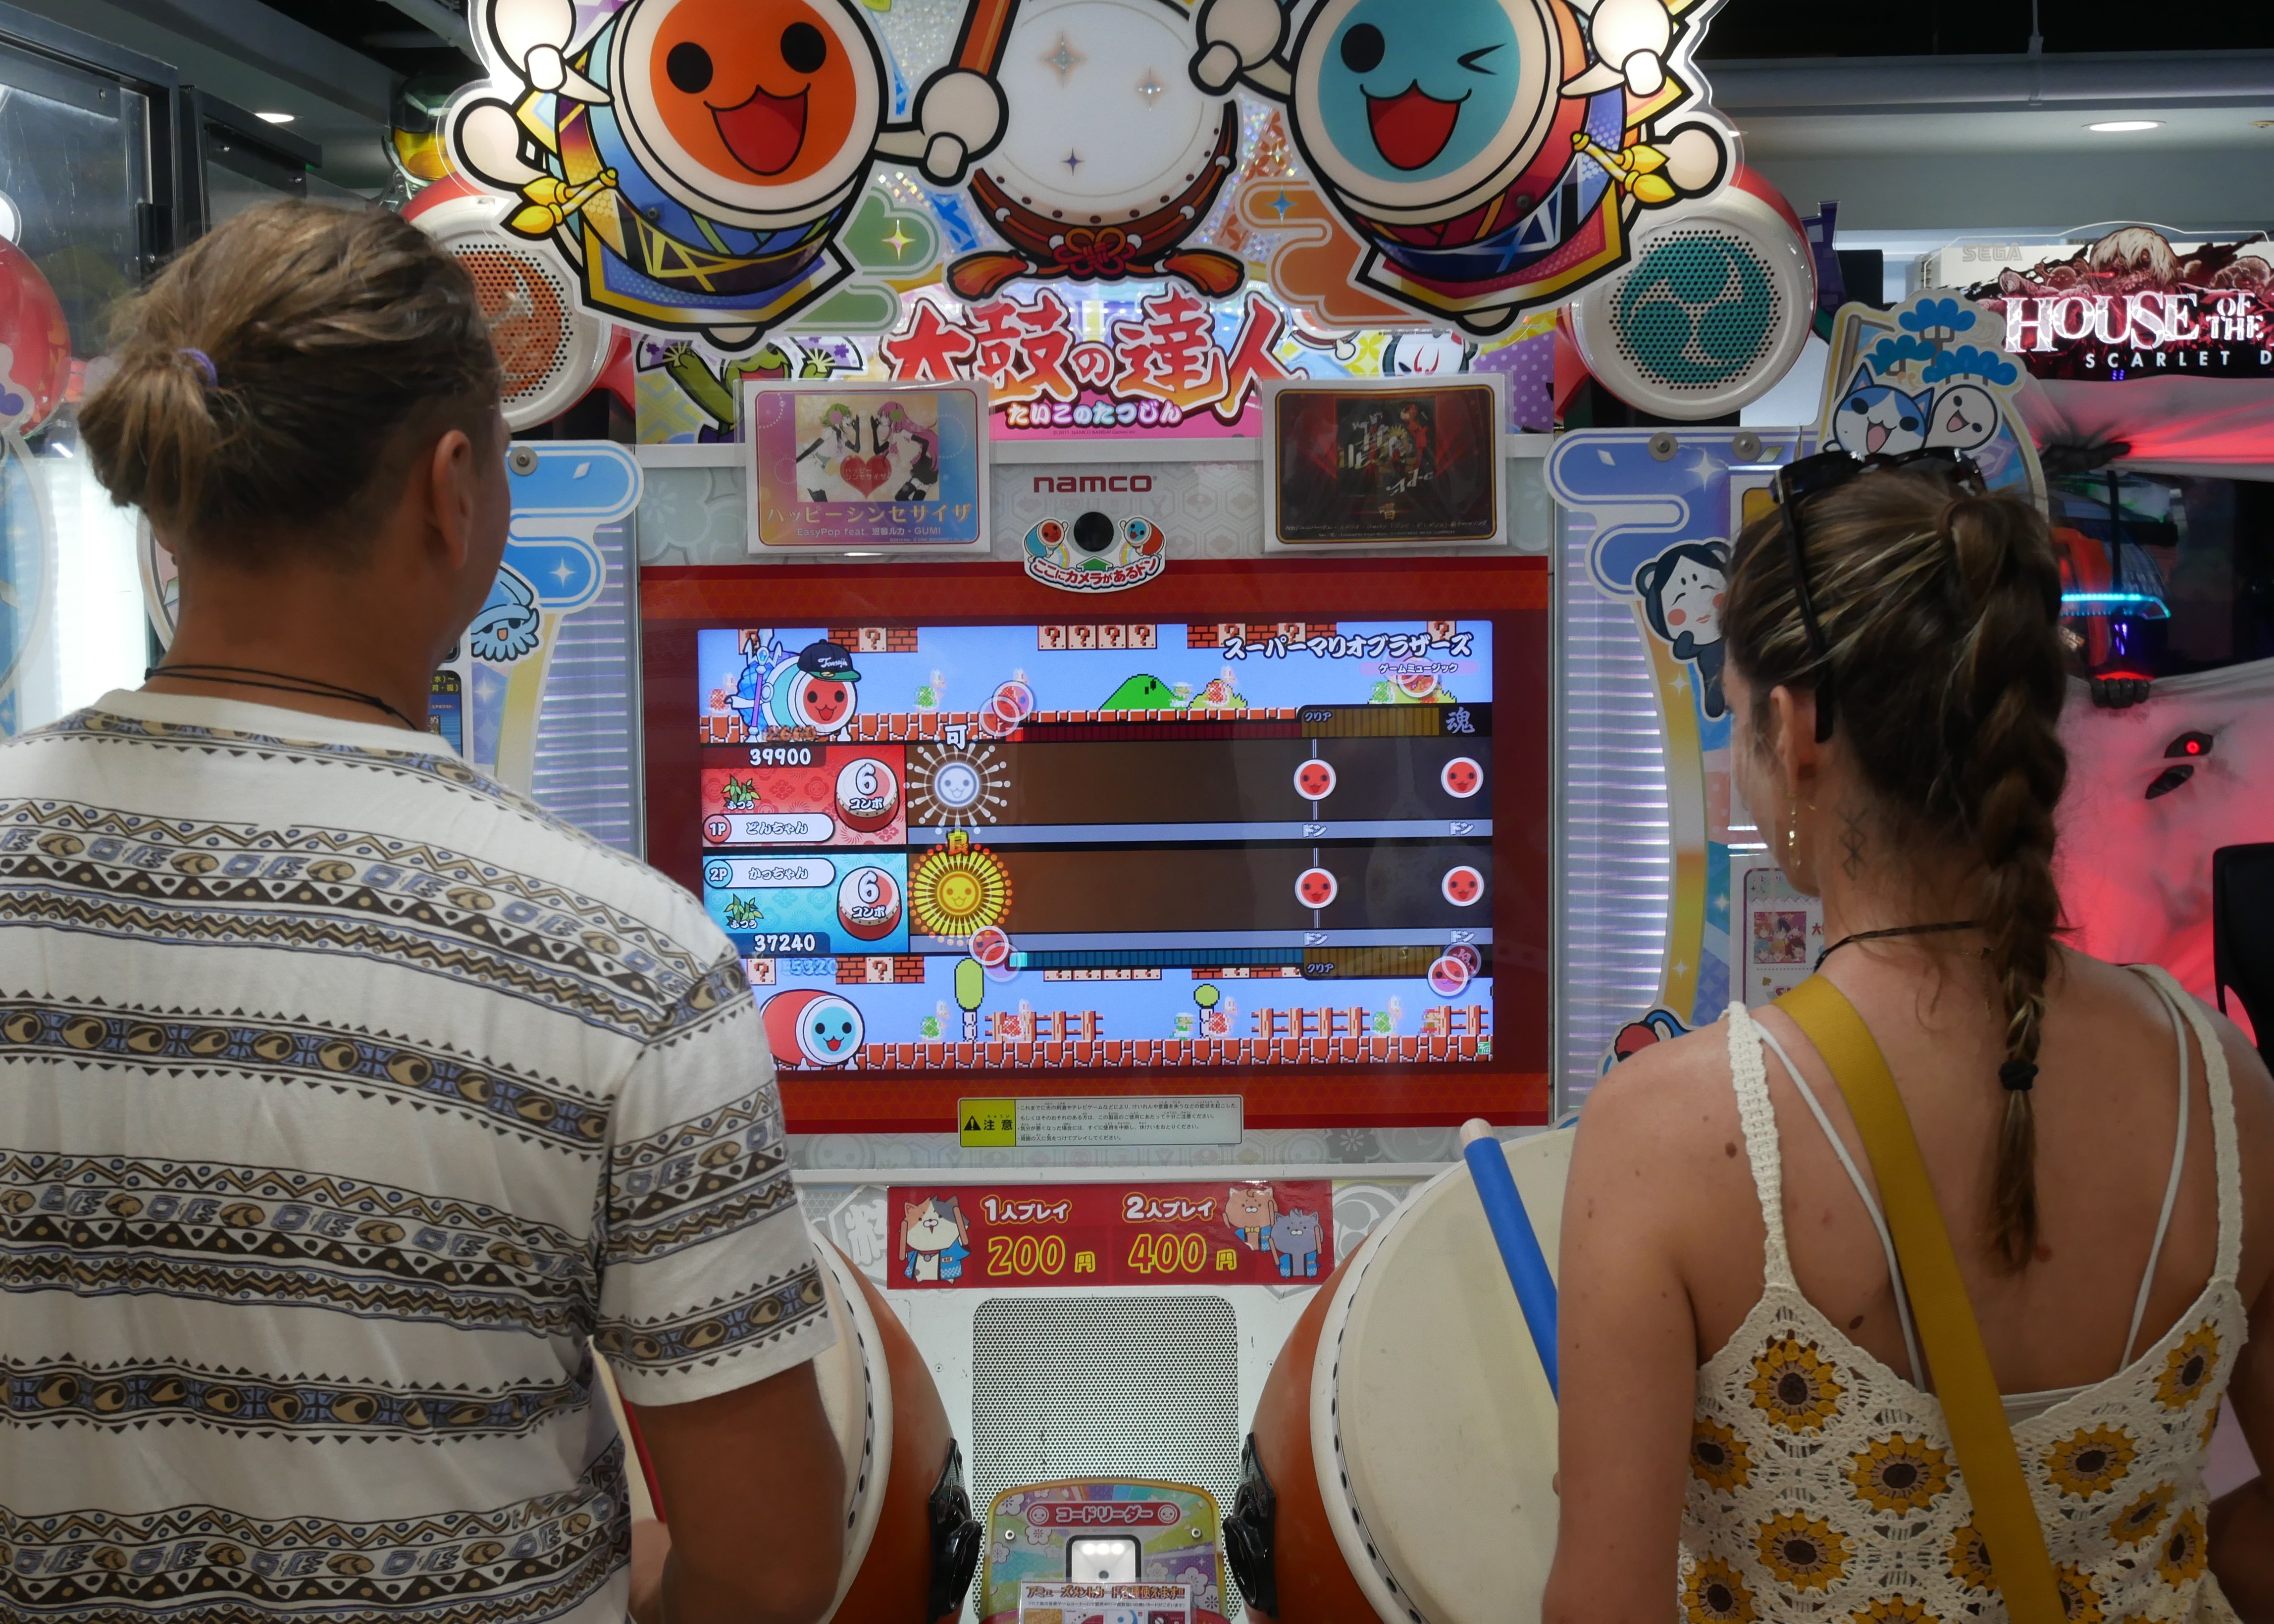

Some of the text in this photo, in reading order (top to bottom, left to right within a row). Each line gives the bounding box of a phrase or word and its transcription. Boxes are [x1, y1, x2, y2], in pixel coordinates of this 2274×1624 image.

[1963, 243, 2023, 262] SEGA
[2217, 293, 2255, 317] OF
[2001, 290, 2199, 353] HOUSE
[2206, 315, 2264, 341] THE
[2086, 351, 2230, 368] SCARLET
[1006, 402, 1183, 426] たいこのたつじん
[1034, 475, 1152, 493] namco
[767, 503, 971, 523] ハッピーシンセサイザ
[797, 528, 840, 538] EasyPop
[1032, 557, 1159, 586] ここにカメラがあるドン
[1223, 632, 1474, 660] スーパーマリオブラザーズ
[1378, 662, 1458, 674] ゲームミュージック
[1305, 711, 1332, 722] クリア
[1446, 707, 1476, 734] 魂
[945, 724, 968, 750] 可
[749, 748, 812, 766] 39900
[856, 763, 878, 795] 6
[726, 801, 754, 810] ふつう
[849, 797, 884, 810] コンボ
[709, 822, 726, 836] 1P
[746, 821, 809, 835] どんちゃん
[1302, 823, 1327, 838] ドン
[1450, 821, 1475, 836] ドン
[710, 866, 728, 881] 2P
[748, 867, 809, 880] かっちゃん
[857, 870, 879, 903] 6
[852, 906, 887, 919] コンボ
[730, 919, 758, 929] ふつう
[754, 934, 816, 952] 37240
[1303, 931, 1329, 946] ドン
[1450, 930, 1474, 943] ドン
[1306, 962, 1334, 974] クリア
[983, 1119, 1013, 1131] 注意
[983, 1197, 1073, 1222] 1人プレイ
[1123, 1195, 1216, 1222] 2人プレイ
[987, 1235, 1096, 1276] 200 円
[1128, 1233, 1238, 1274] 400 円
[1055, 1506, 1154, 1524] コードリーダー
